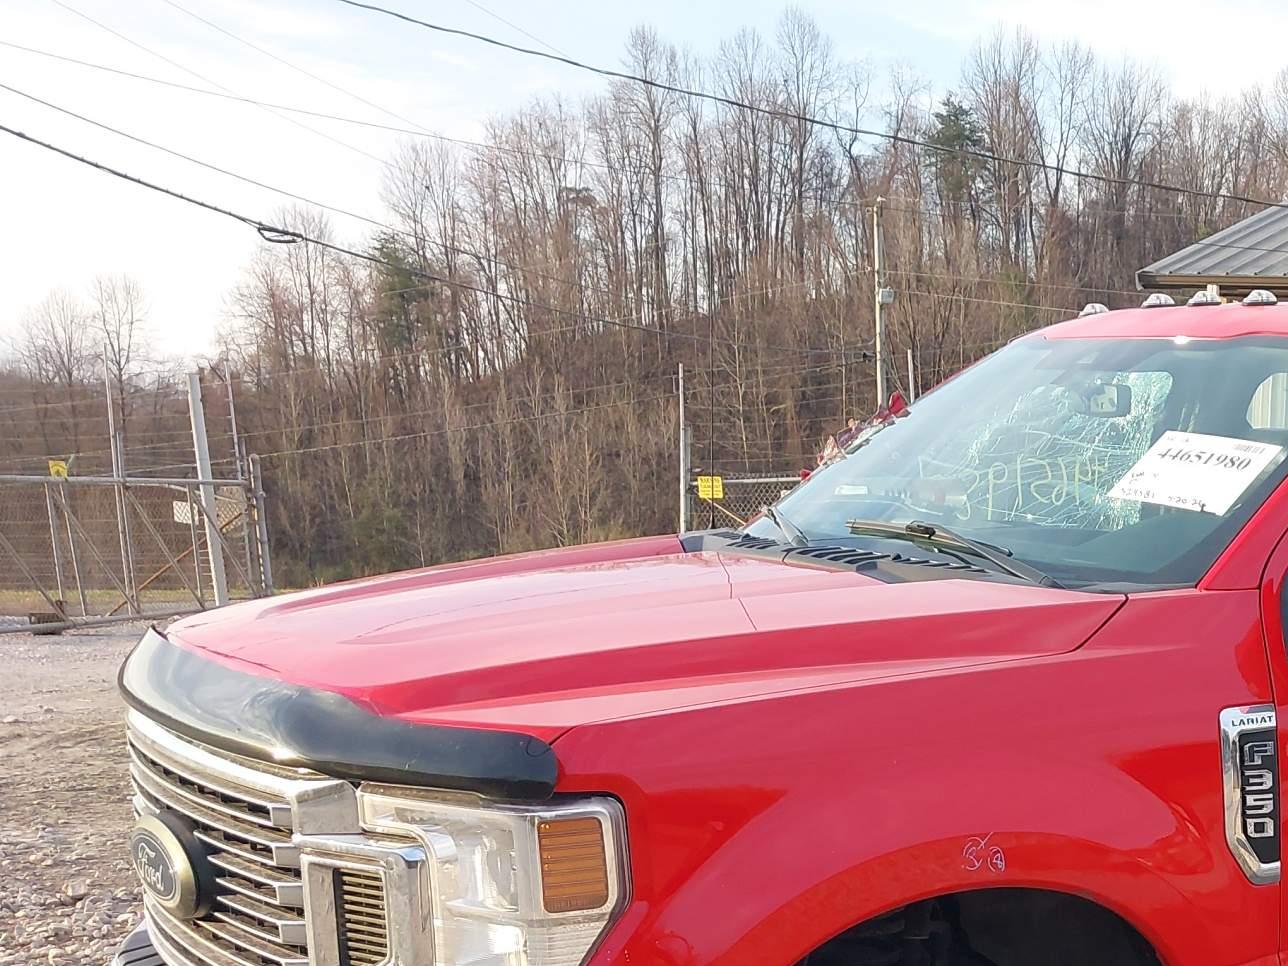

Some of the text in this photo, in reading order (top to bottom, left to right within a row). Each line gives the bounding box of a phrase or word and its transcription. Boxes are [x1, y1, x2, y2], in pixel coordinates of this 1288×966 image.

[1156, 447, 1252, 472] 44651980
[1231, 715, 1274, 727] LARIAT
[1242, 740, 1275, 839] F350
[137, 842, 165, 892] Ford
